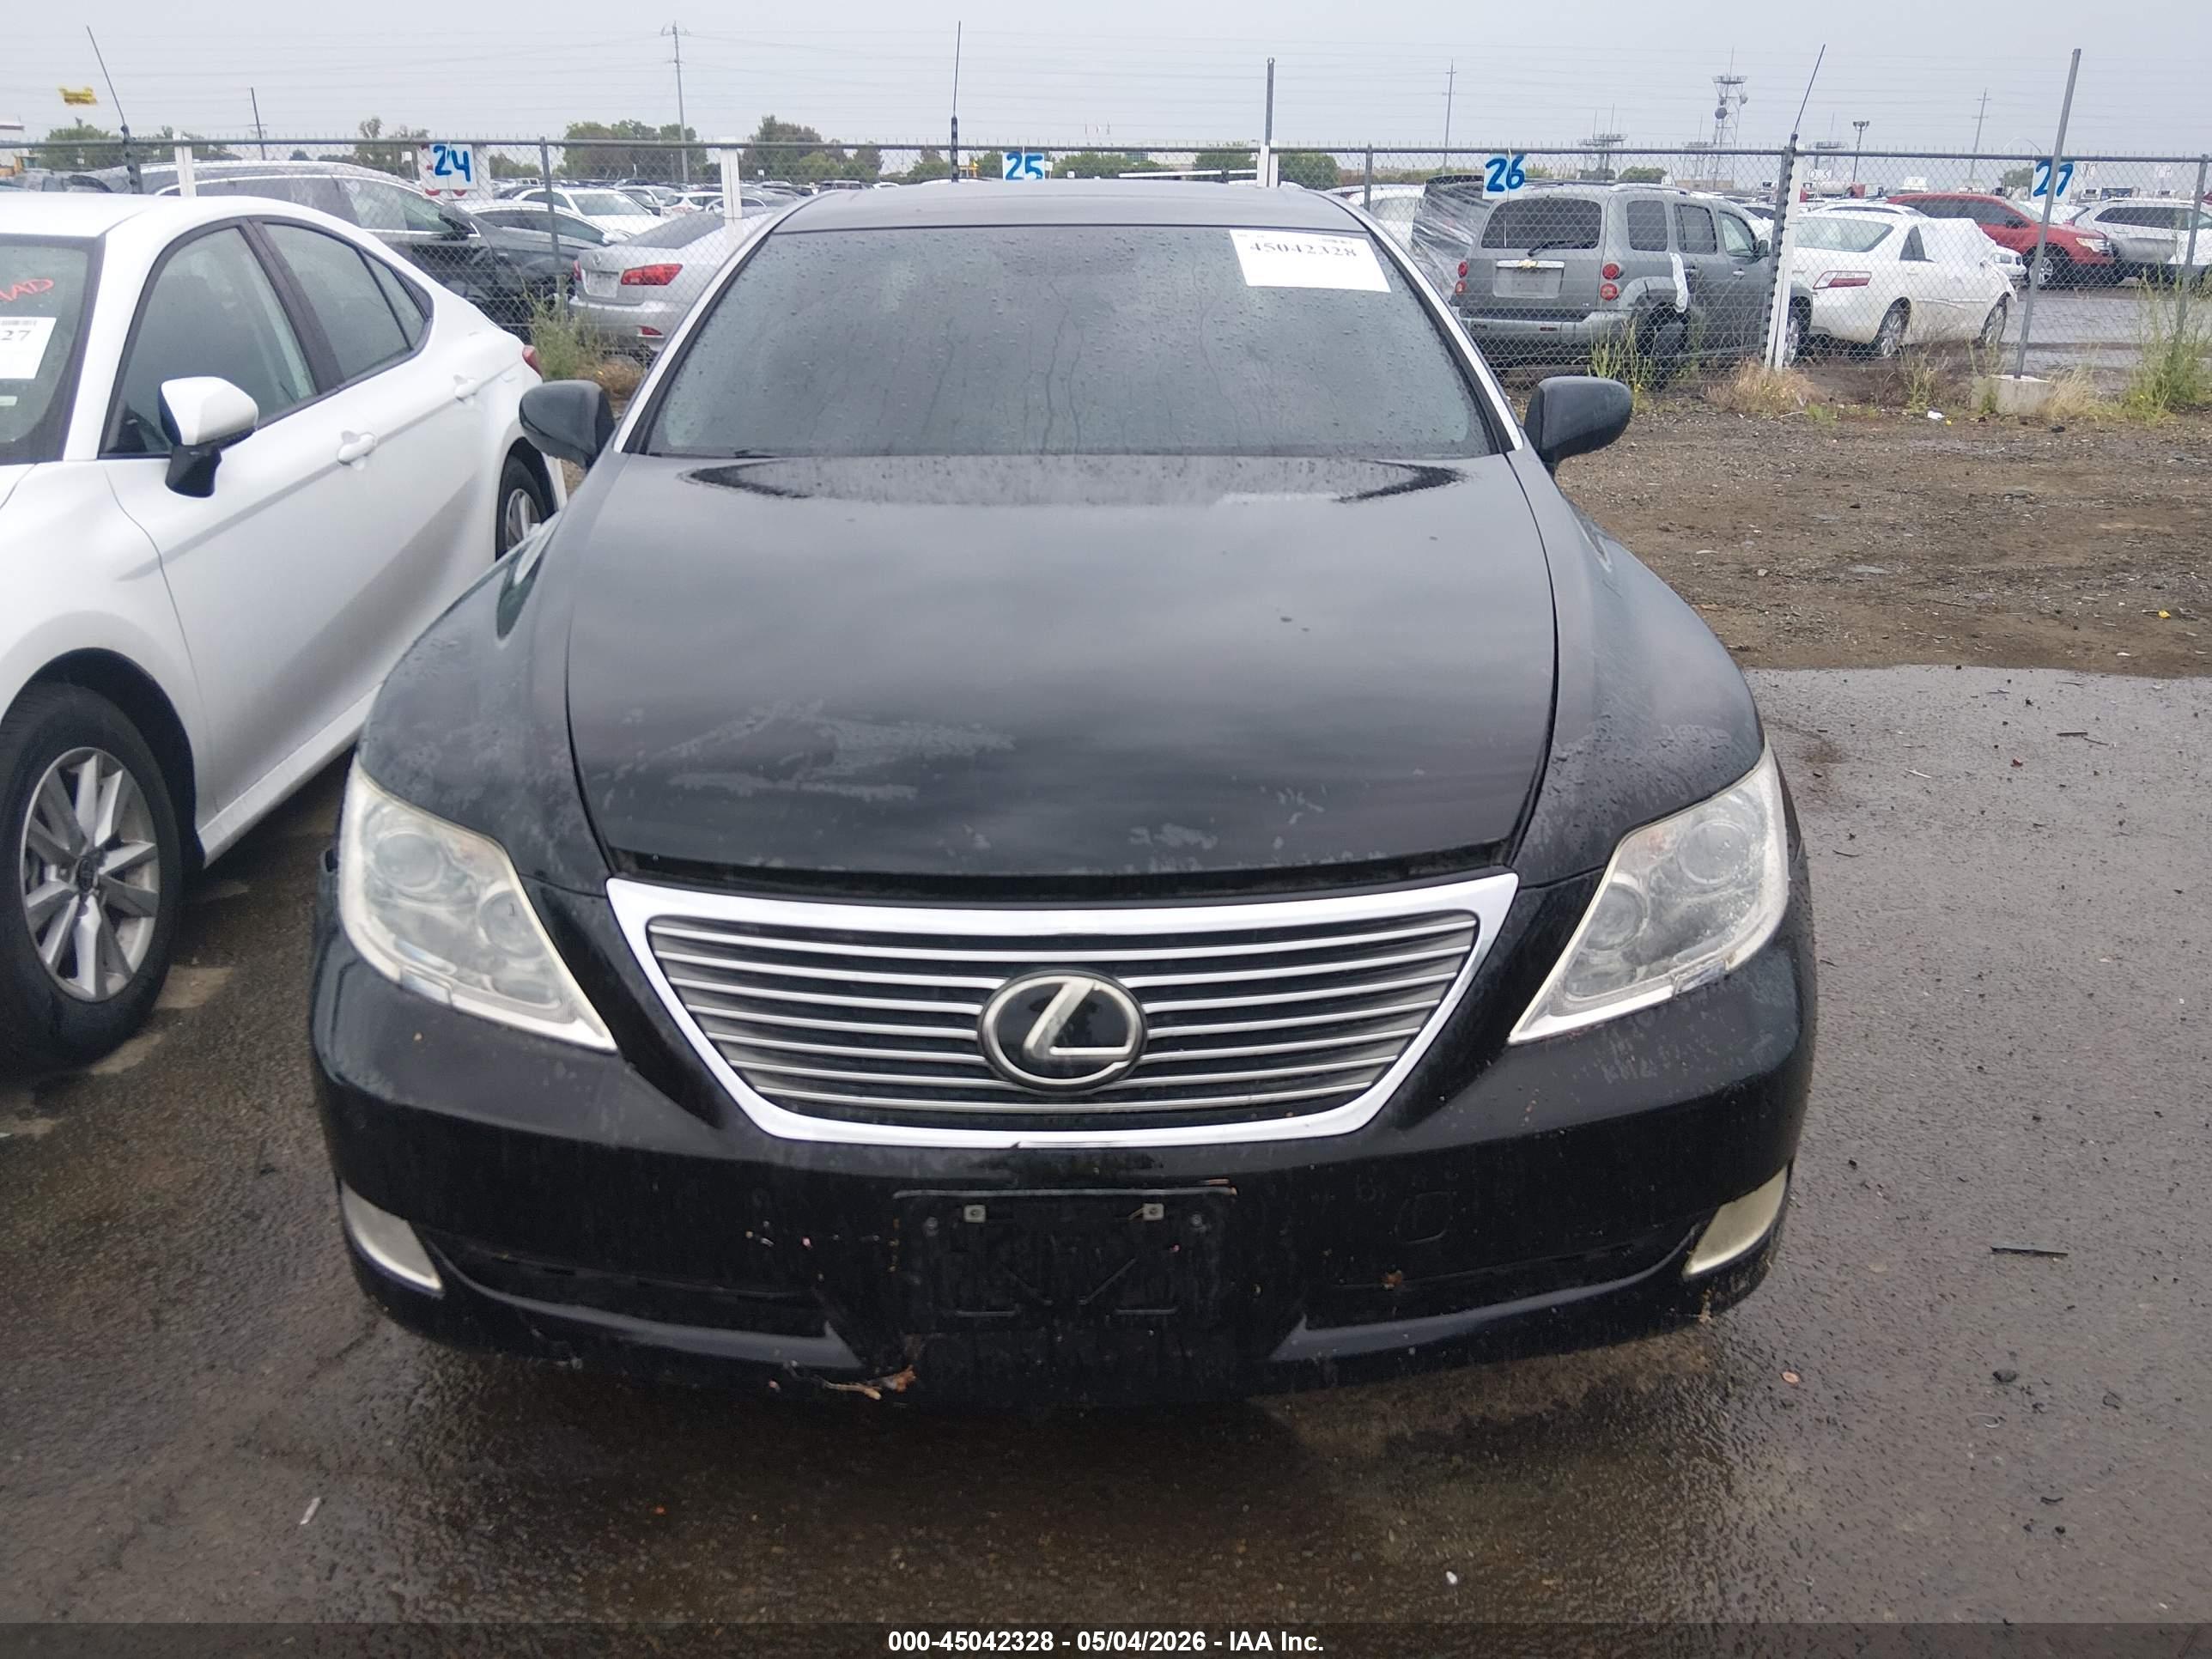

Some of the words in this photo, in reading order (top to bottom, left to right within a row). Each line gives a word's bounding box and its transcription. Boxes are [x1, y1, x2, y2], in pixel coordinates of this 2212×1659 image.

[433, 145, 471, 182] 24
[1006, 151, 1043, 180] 25
[1486, 153, 1525, 192] 26
[2033, 160, 2074, 197] 27
